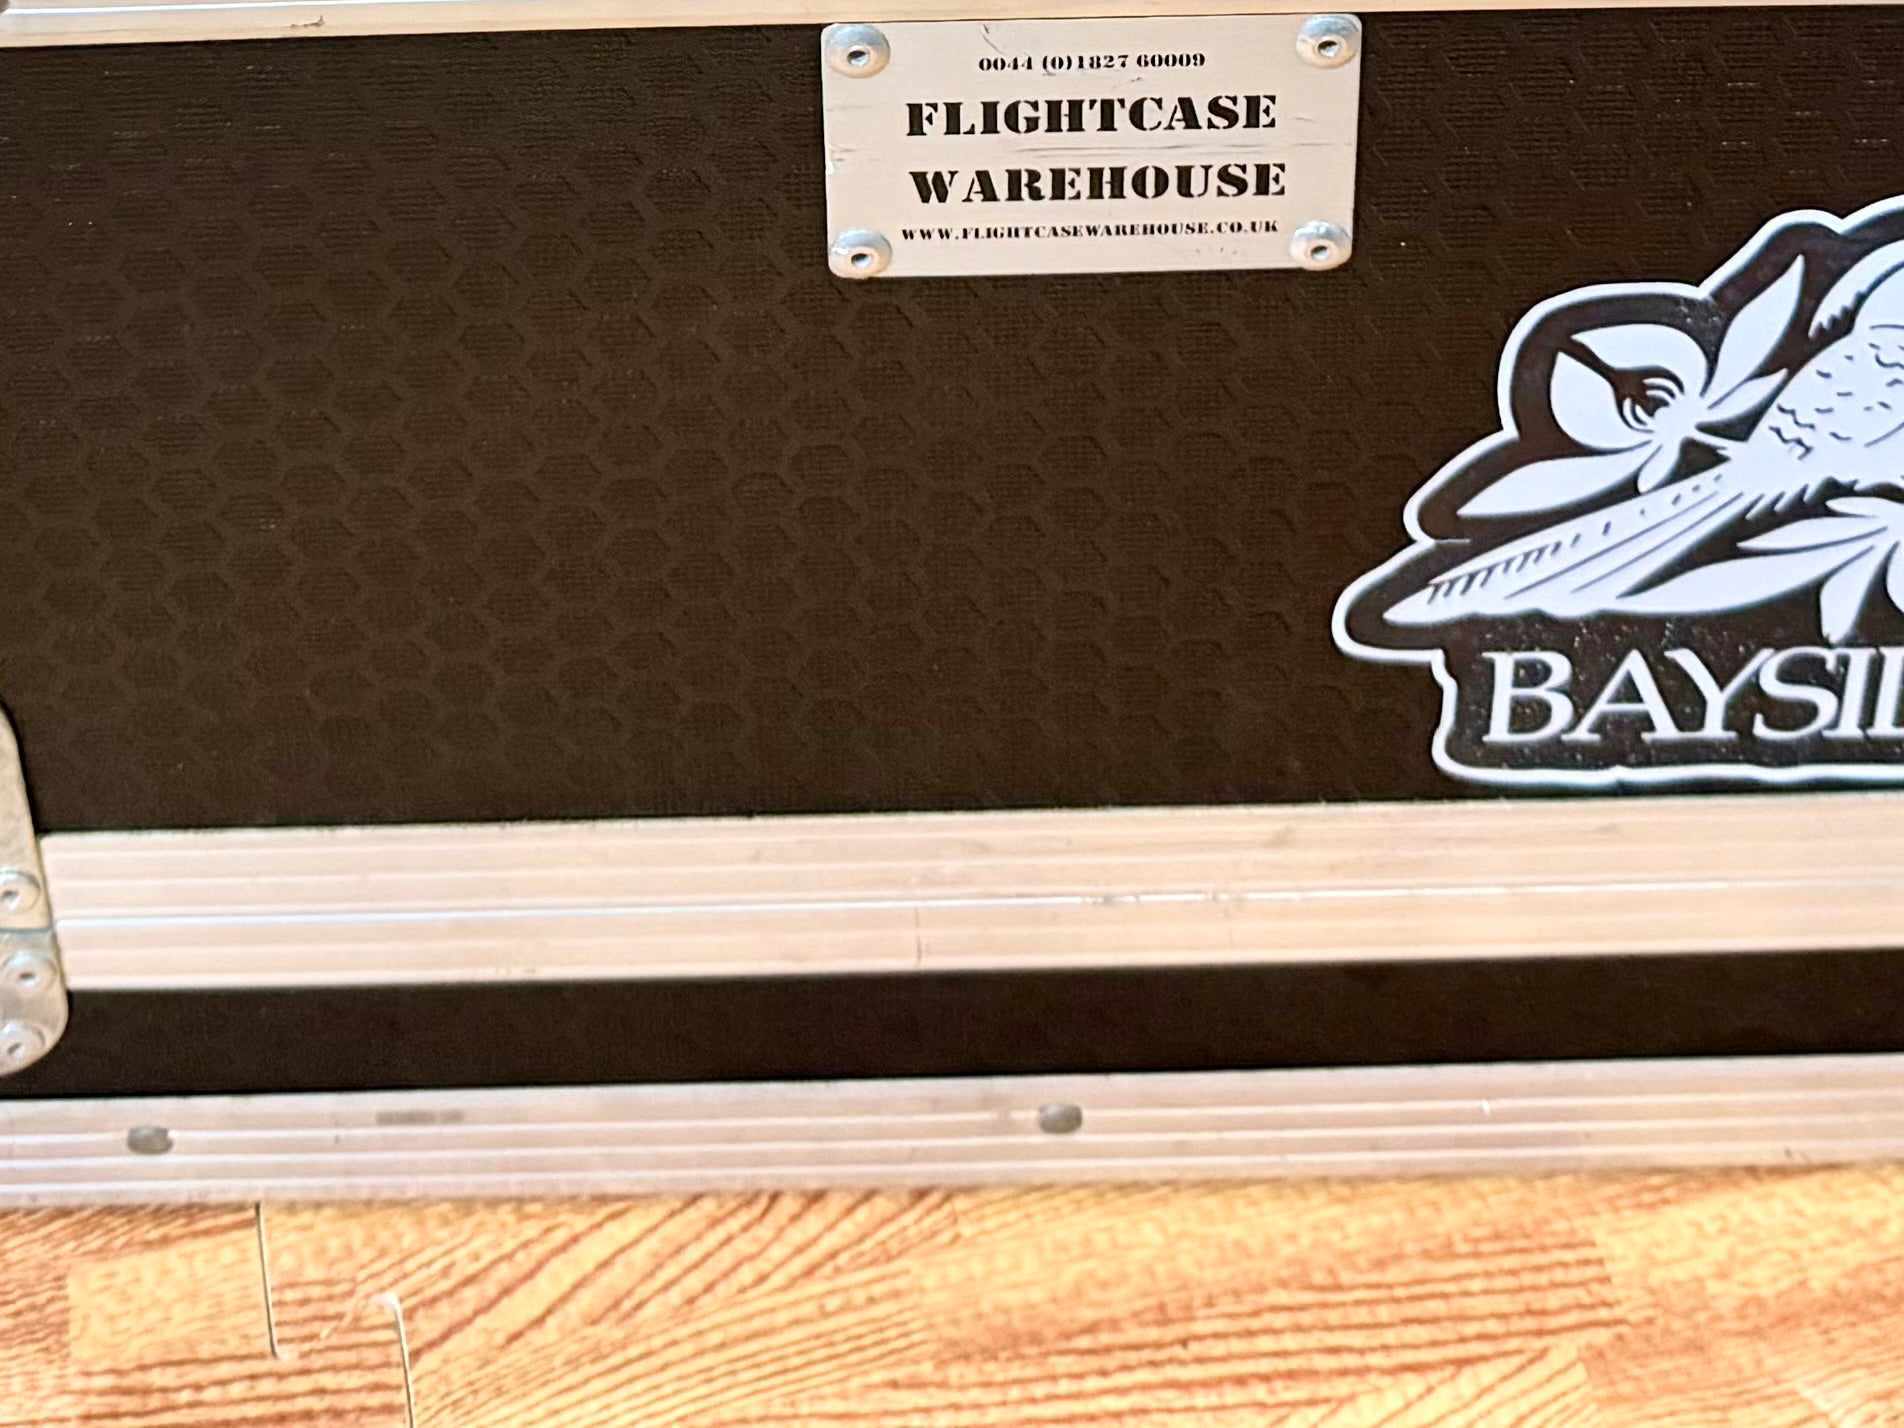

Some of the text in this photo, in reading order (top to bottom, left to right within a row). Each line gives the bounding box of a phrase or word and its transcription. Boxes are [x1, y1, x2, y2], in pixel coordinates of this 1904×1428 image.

[978, 52, 1207, 72] 0044 (0)1827 60009
[904, 93, 1278, 137] FLIGHTCASE
[908, 161, 1287, 205] WAREHOUSE
[901, 218, 1280, 242] WWW.FLIGHTCASEWAREHOUSE.CO.UK
